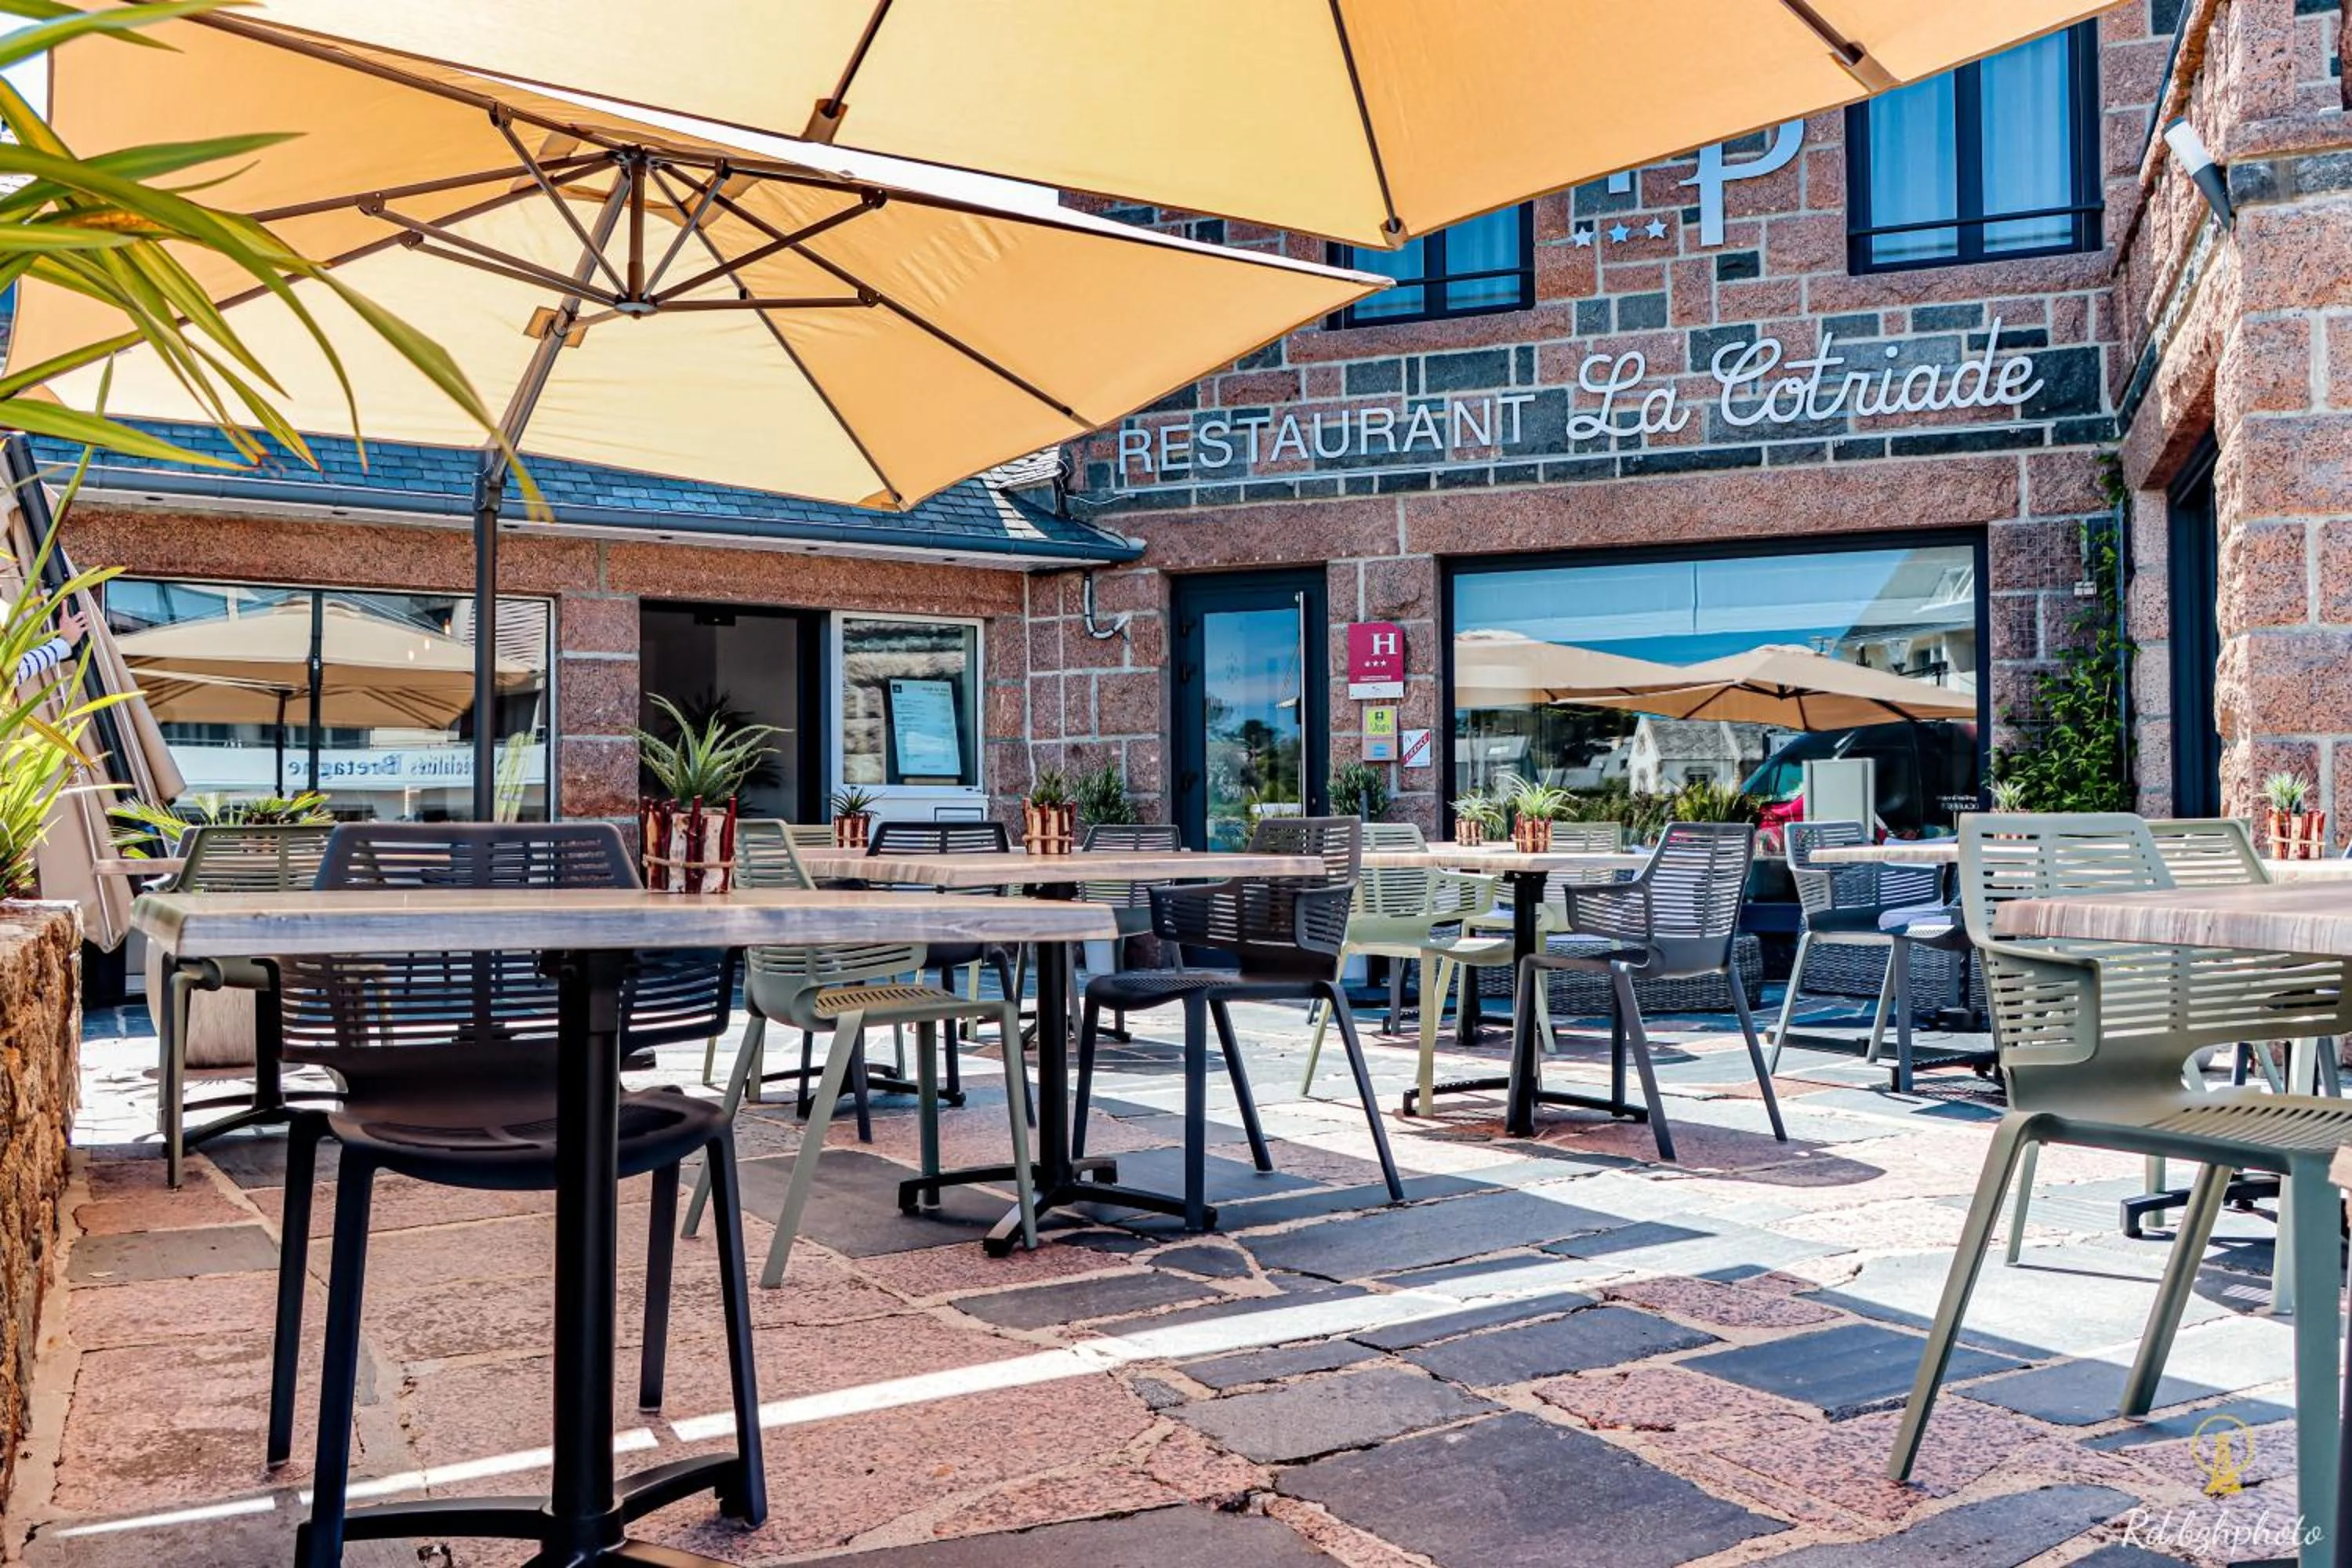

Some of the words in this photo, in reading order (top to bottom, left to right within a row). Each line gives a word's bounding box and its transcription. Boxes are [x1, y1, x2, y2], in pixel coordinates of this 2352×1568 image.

[1119, 394, 1536, 474] RESTAURANT
[1566, 350, 1691, 440] La
[1711, 316, 2045, 426] Cotriade
[1371, 633, 1397, 655] H
